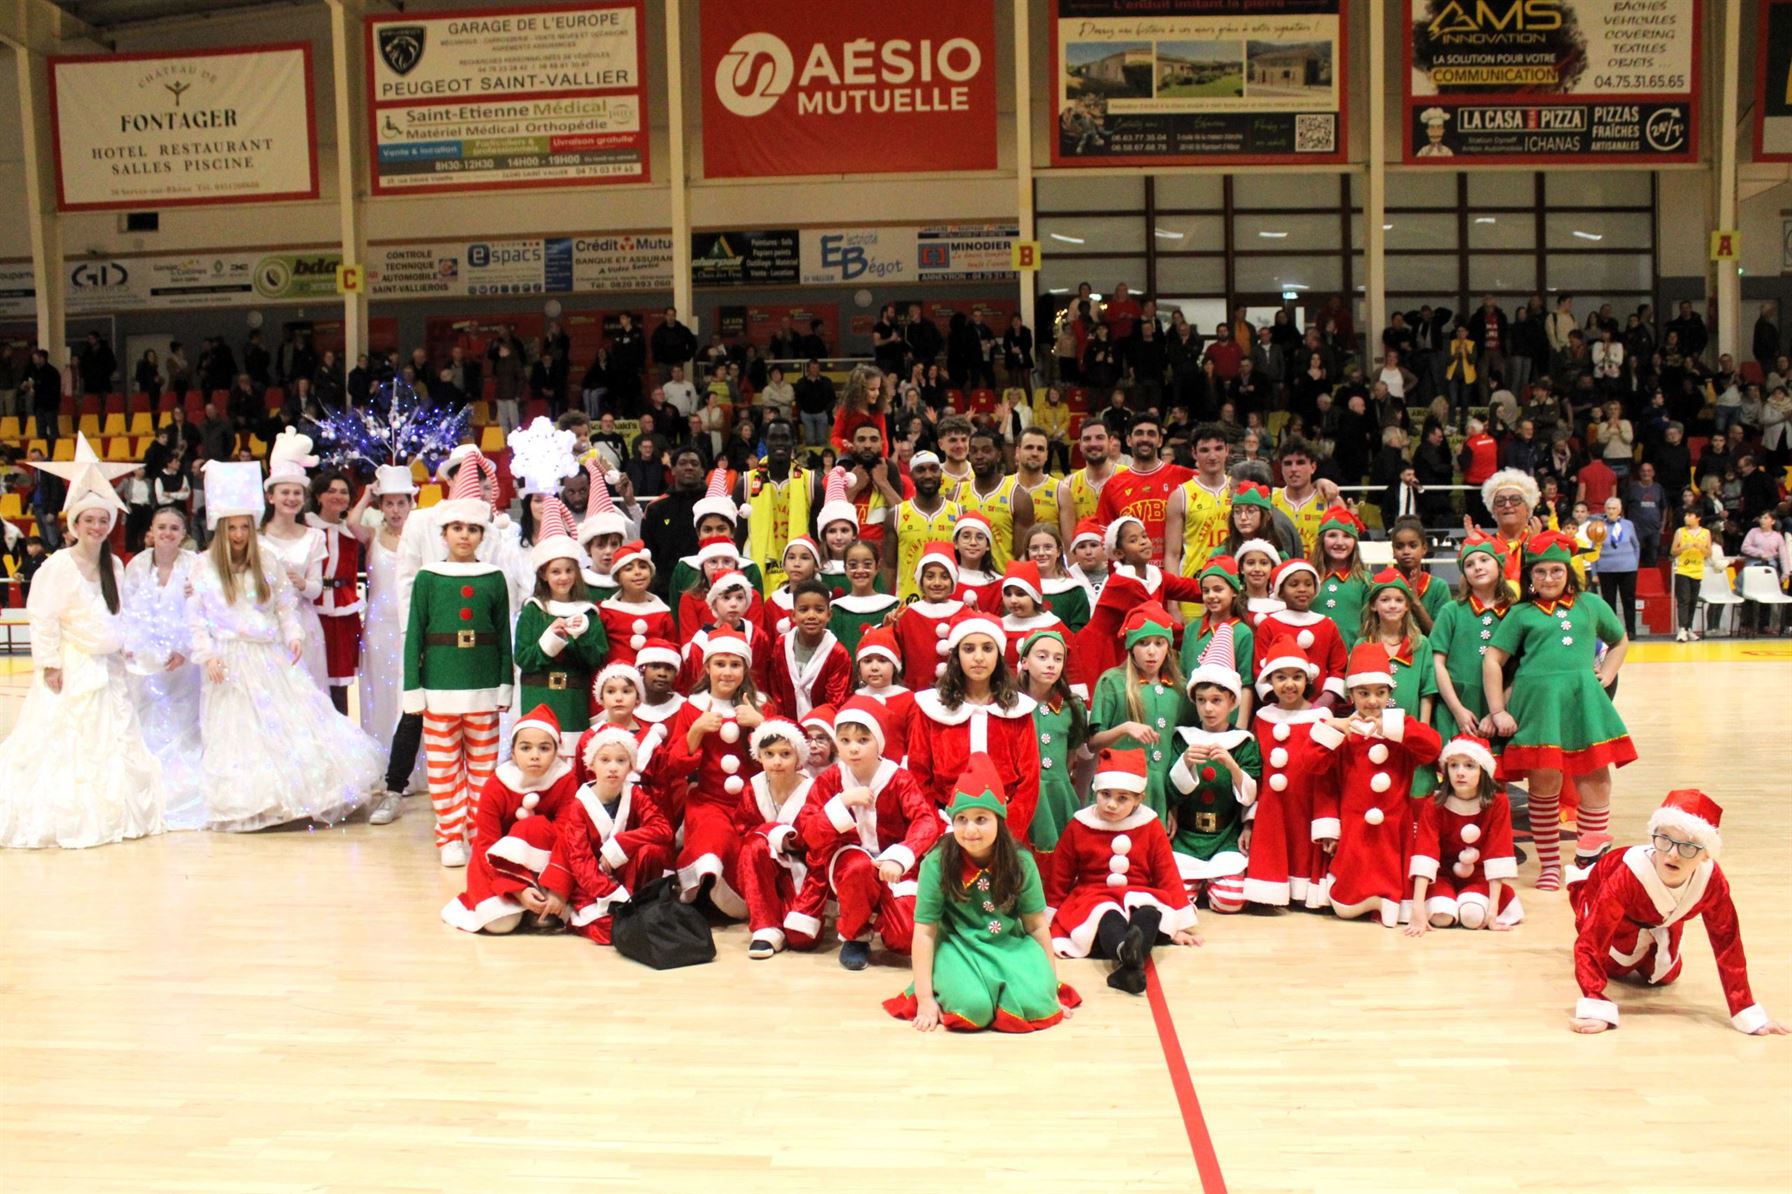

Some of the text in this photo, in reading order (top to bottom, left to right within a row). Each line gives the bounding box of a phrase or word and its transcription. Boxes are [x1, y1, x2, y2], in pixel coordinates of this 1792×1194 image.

[448, 13, 620, 35] GARAGE DE L'EUROPE
[1428, 0, 1561, 38] AMS
[1604, 15, 1676, 25] VEHICULES
[1443, 33, 1545, 44] INNOVATION
[1604, 30, 1675, 40] COVERING
[1613, 43, 1666, 53] TEXTILES
[799, 38, 981, 86] AÉSIO
[1433, 53, 1556, 64] LA SOLUTION POUR VOTRE
[382, 69, 629, 97] PEUGEOT SAINT-VALLIER
[1433, 68, 1556, 82] COMMUNICATION
[1594, 75, 1685, 88] 04.75.31.65.65
[798, 87, 969, 115] MUTUELLE
[406, 104, 529, 124] Saint-Etienne
[532, 99, 607, 116] Médical
[1463, 111, 1482, 128] LA
[1485, 110, 1523, 128] CASA
[1541, 110, 1582, 128] PIZZA
[1594, 106, 1640, 122] PIZZAS
[121, 108, 237, 133] FONTAGER
[406, 119, 608, 140] Matériel Médical Orthopédie
[91, 138, 274, 160] HOTEL RESTAURANT
[552, 136, 595, 147] Livraison
[111, 156, 254, 176] SALLES PISCINE
[507, 156, 540, 168] 14H00
[548, 154, 581, 166] 19H00
[575, 238, 618, 252] Crédit
[951, 241, 1011, 251] MINODIER
[1717, 235, 1733, 256] A
[386, 250, 432, 260] CONTROLE
[575, 257, 613, 265] BANQUE
[616, 256, 626, 264] ET
[842, 246, 903, 280] Bégot
[1020, 245, 1033, 266] B
[385, 261, 434, 271] TECHNIQUE
[344, 270, 356, 289] C
[382, 272, 438, 282] AUTOMOBILE
